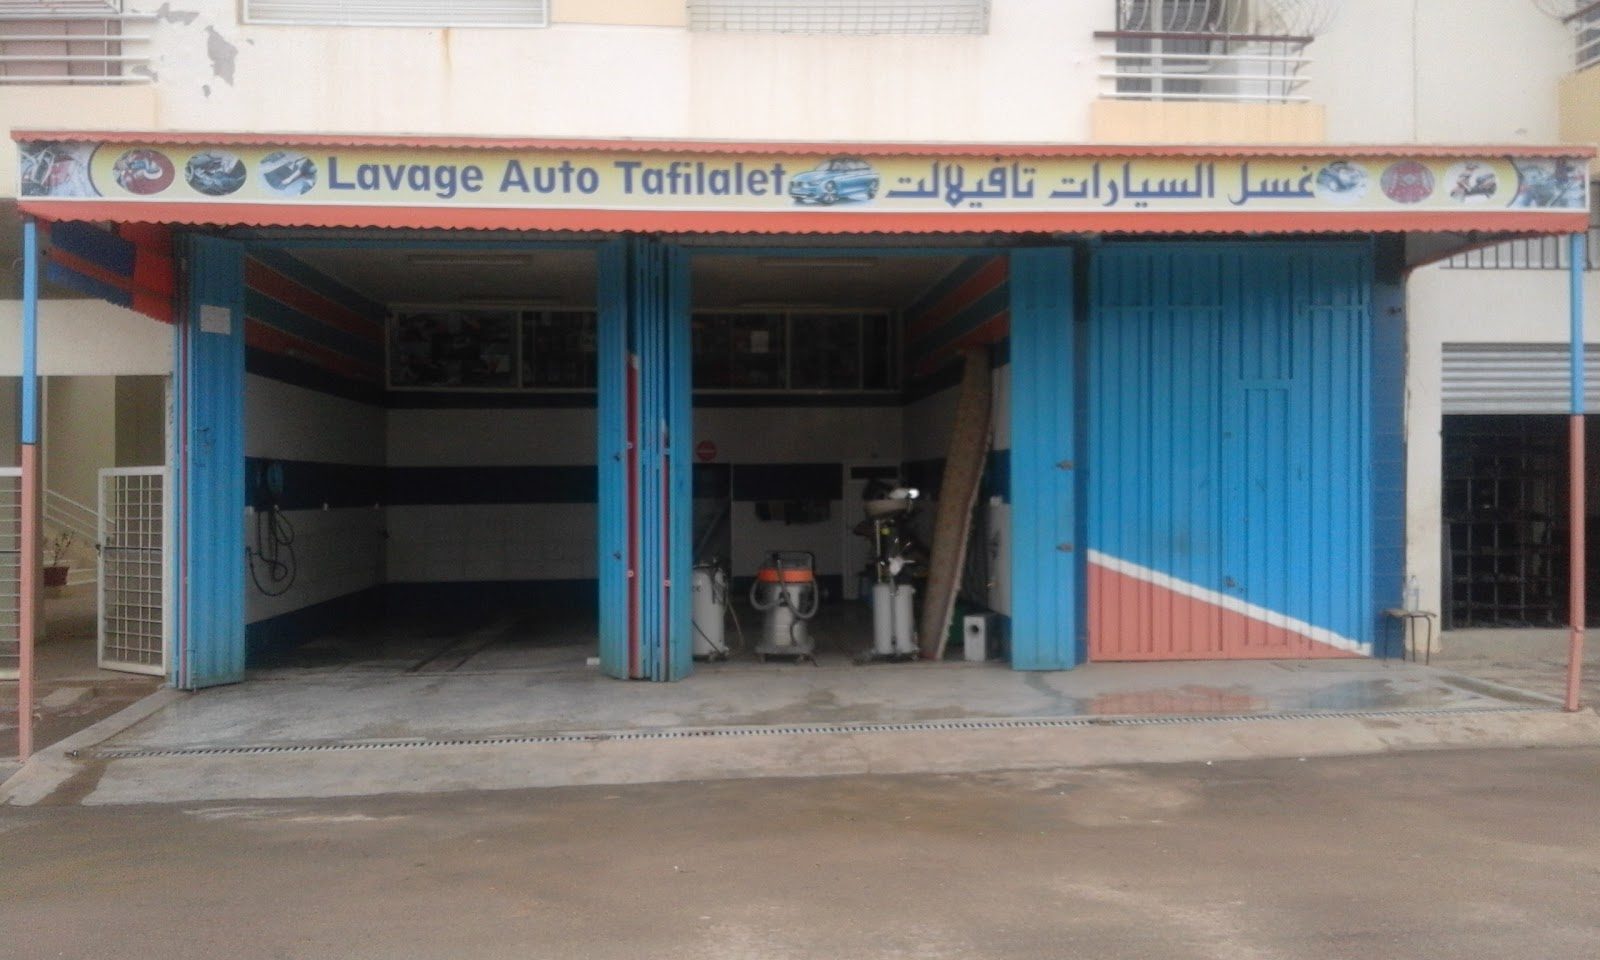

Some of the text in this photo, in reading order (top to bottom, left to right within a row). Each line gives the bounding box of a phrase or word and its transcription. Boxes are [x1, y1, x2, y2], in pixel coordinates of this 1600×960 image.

[328, 157, 786, 199] Lavage Auto Tafilalet
[885, 157, 1315, 208] غسل السيارات تافيلالت
